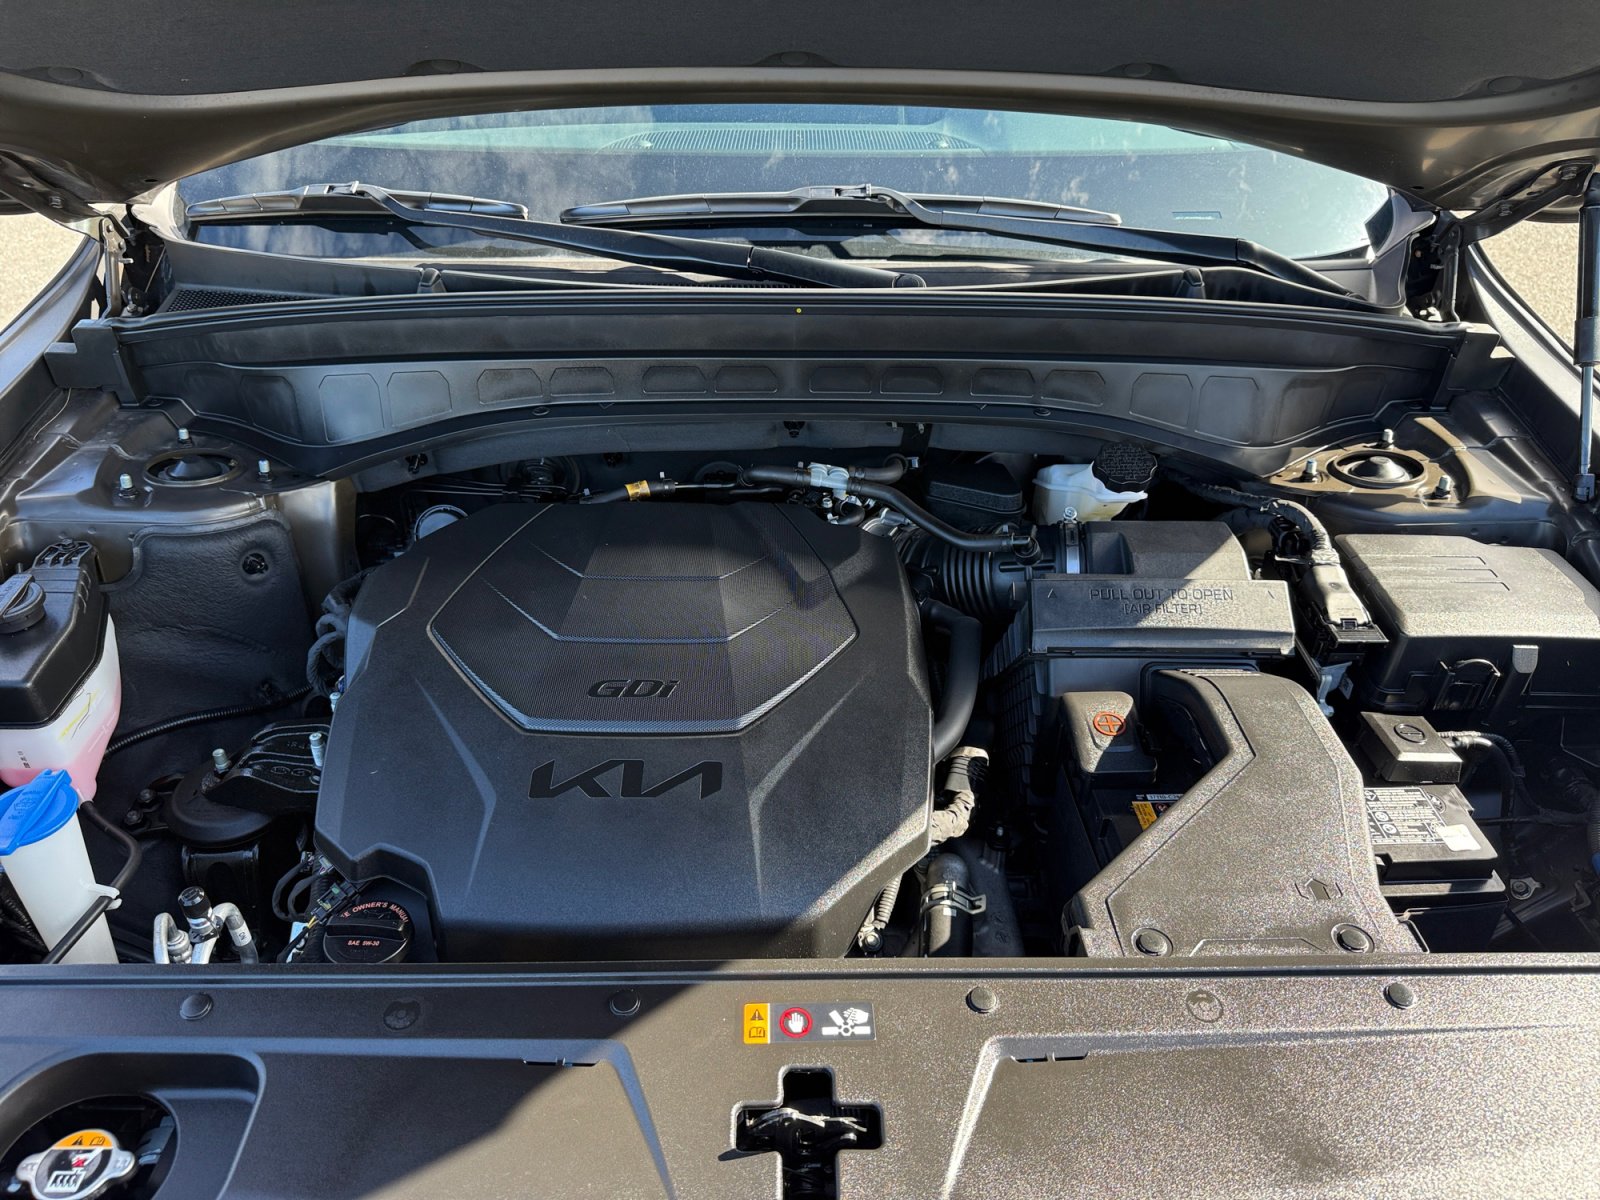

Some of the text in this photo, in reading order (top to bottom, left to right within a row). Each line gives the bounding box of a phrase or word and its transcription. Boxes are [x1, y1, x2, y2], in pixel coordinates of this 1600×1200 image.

[1090, 588, 1233, 600] PULL OUT TO OPEN
[587, 679, 680, 698] GDi
[528, 758, 722, 799] KIA
[352, 901, 389, 913] OWNER'S
